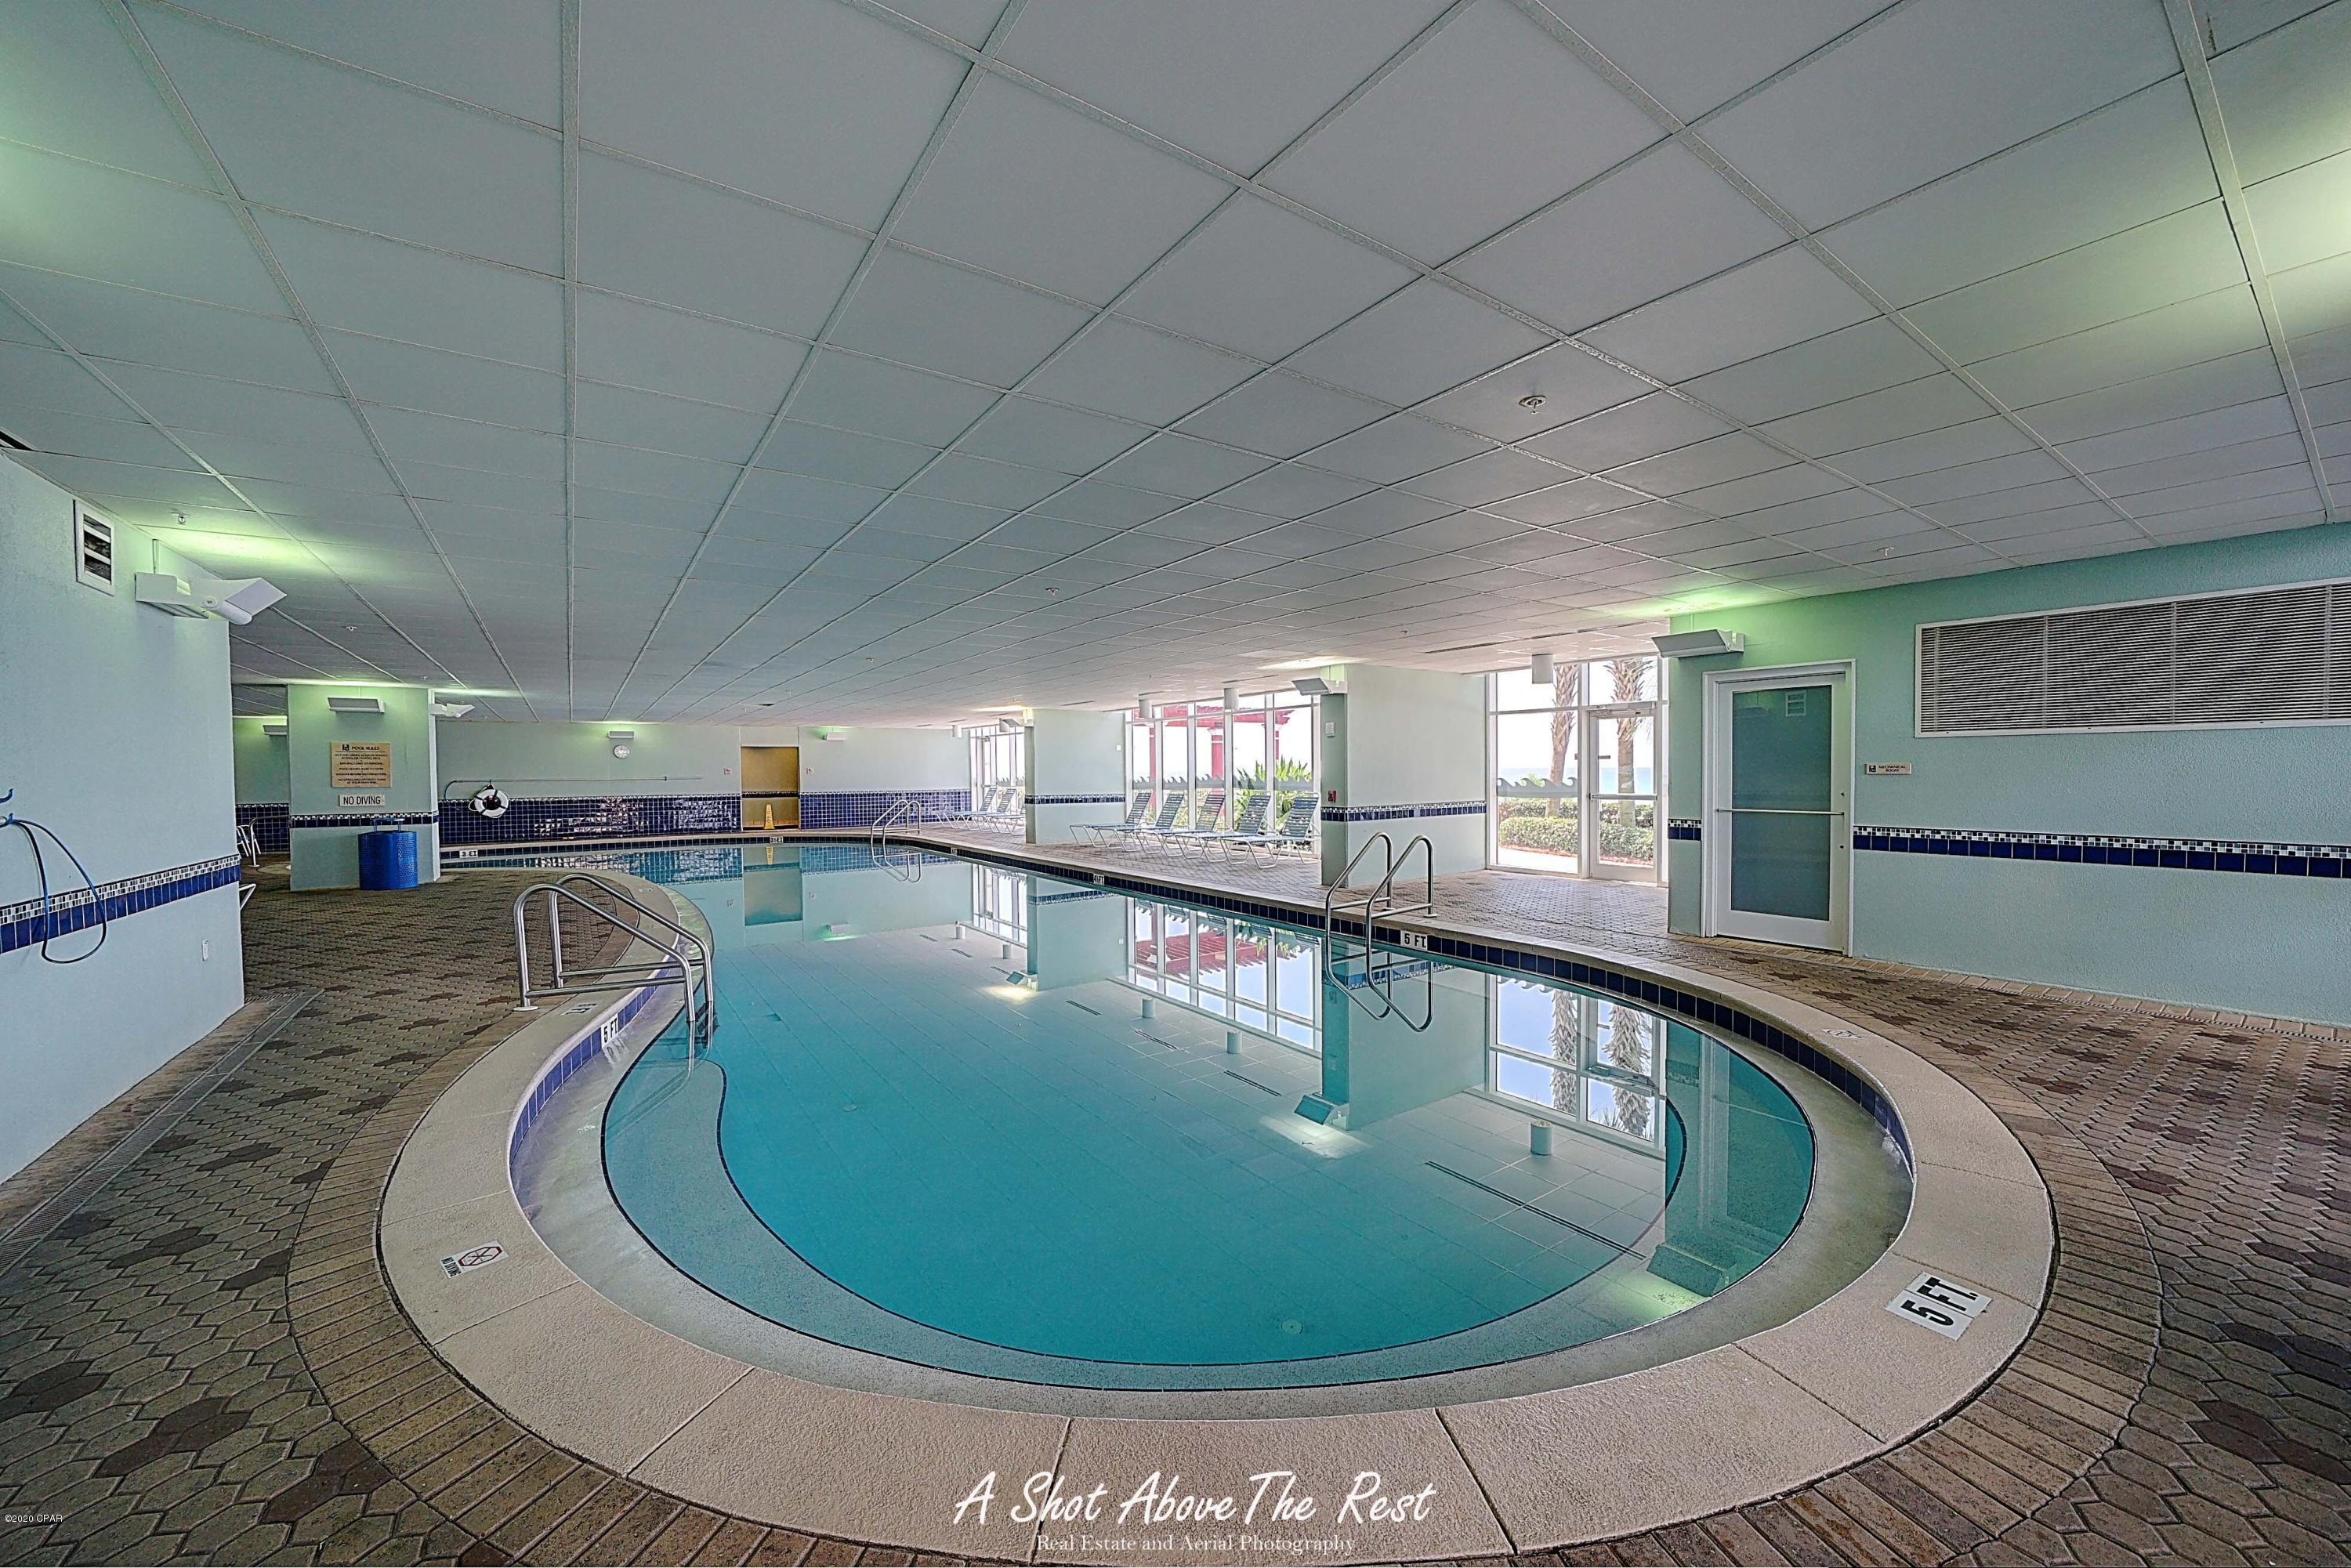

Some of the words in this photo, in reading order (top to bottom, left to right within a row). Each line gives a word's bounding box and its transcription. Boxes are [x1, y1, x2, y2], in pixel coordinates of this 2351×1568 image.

[343, 795, 354, 805] NO
[357, 795, 382, 805] DIVING
[1404, 932, 1411, 945] 5
[603, 1025, 608, 1043] 5
[440, 1256, 455, 1265] NO
[444, 1262, 462, 1277] DIVING
